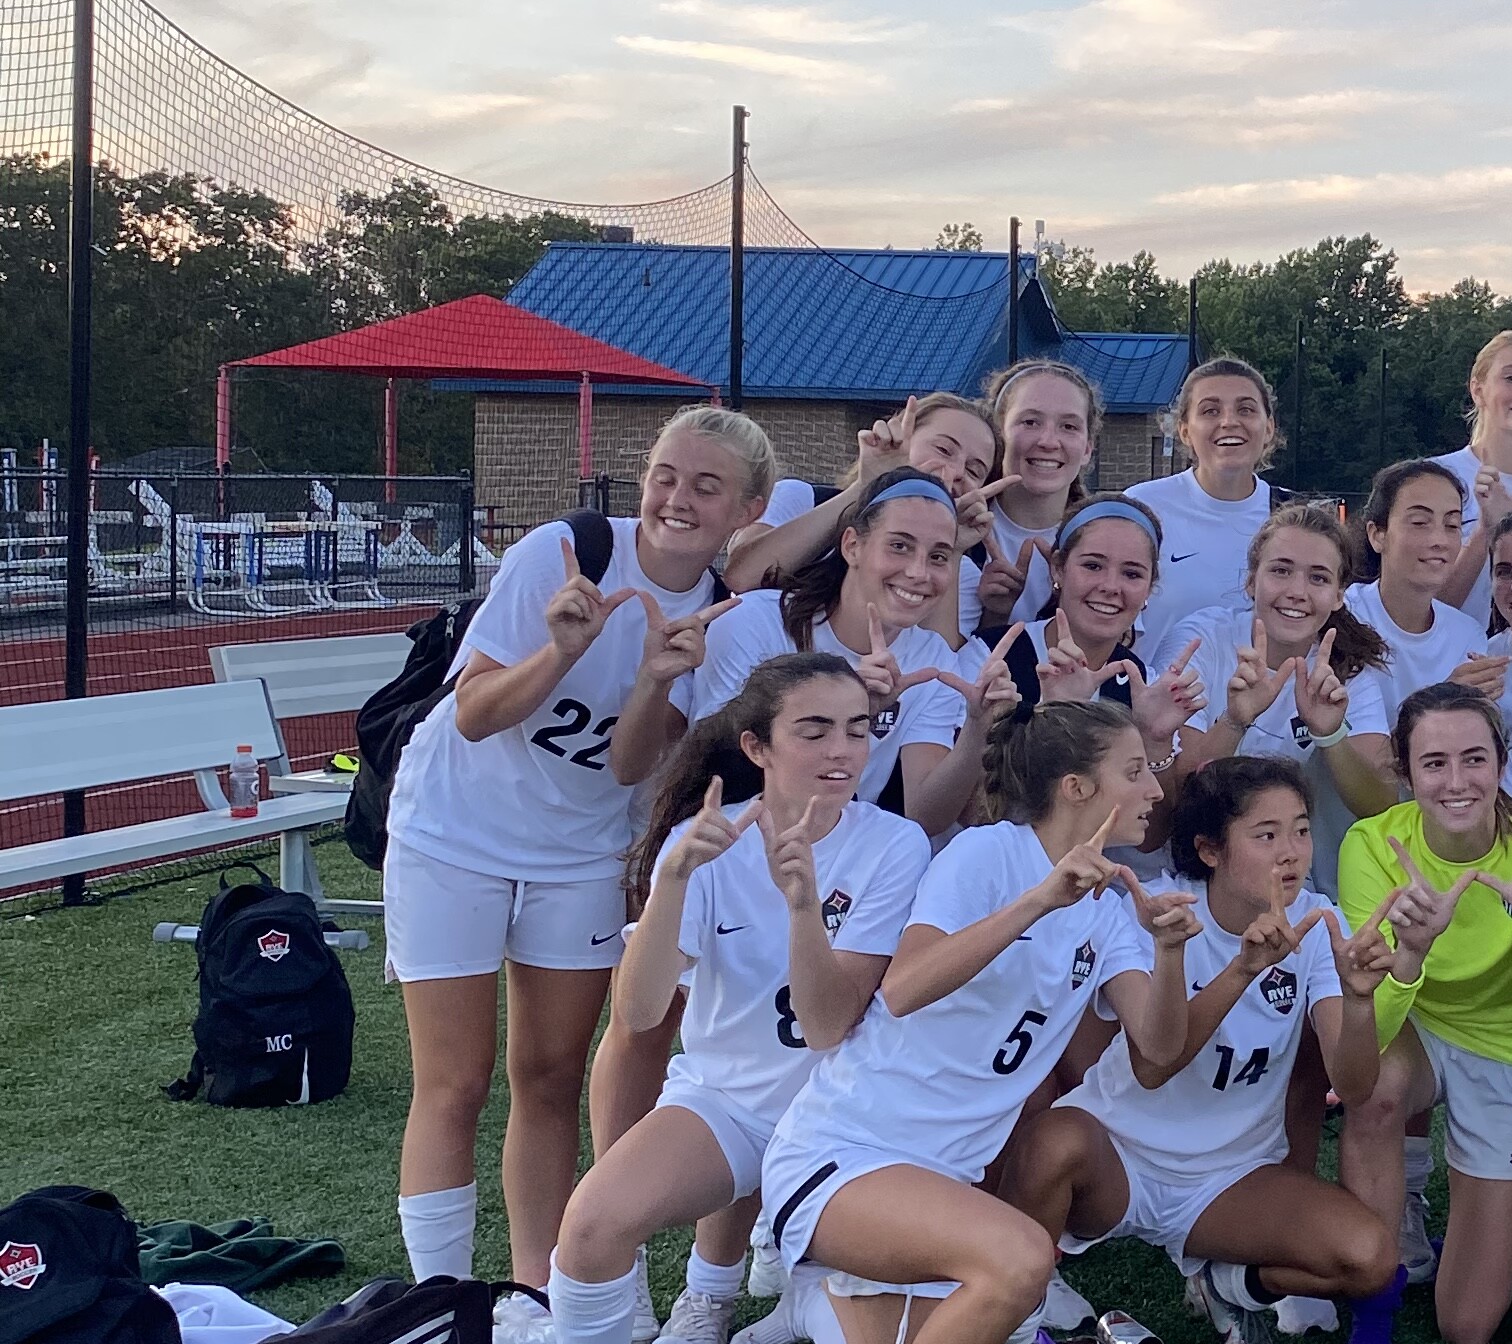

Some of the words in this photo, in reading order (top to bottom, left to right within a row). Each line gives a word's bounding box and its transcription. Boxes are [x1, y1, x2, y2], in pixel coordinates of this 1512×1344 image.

[530, 698, 620, 771] 22
[825, 912, 847, 929] RY
[1073, 960, 1091, 976] RYE
[1266, 985, 1295, 1002] RYE
[264, 1033, 293, 1053] MC
[992, 1010, 1048, 1075] 5
[1211, 1043, 1270, 1092] 14
[6, 1256, 37, 1275] RYE
